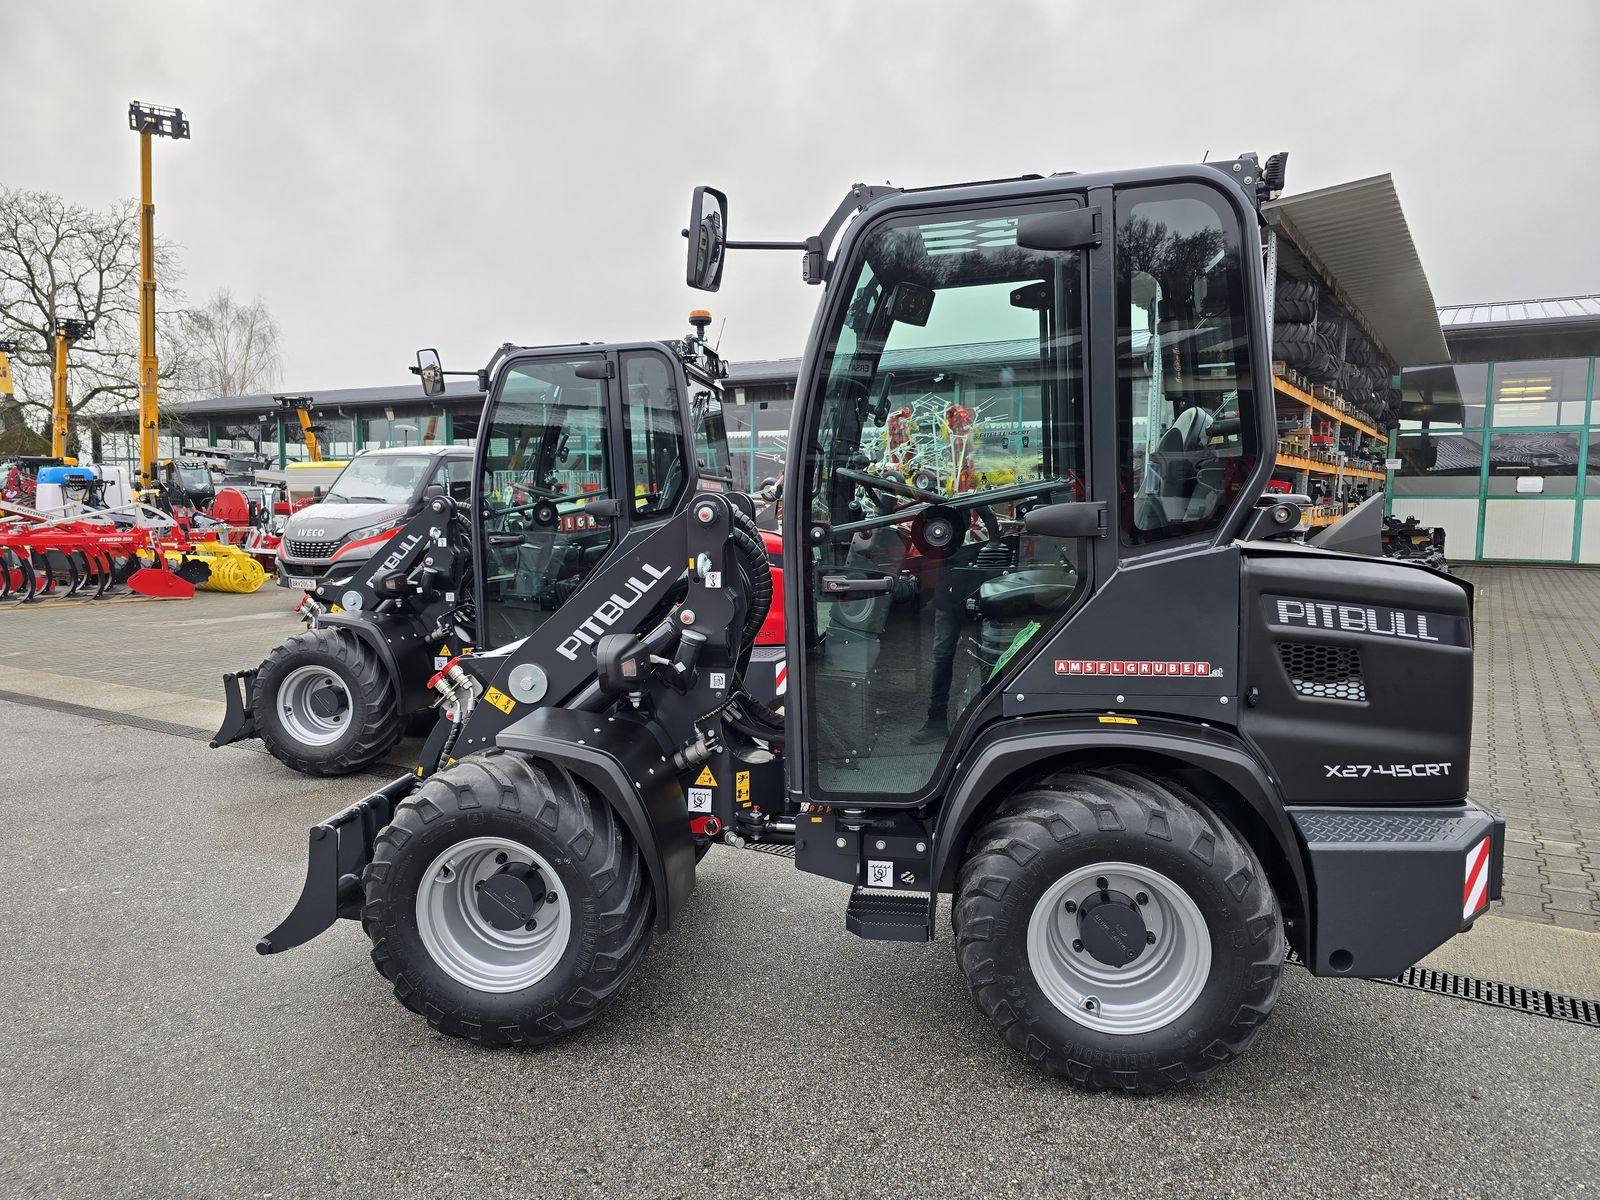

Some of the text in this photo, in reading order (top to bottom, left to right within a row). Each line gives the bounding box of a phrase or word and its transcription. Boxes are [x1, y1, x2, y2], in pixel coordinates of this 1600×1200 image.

[297, 528, 325, 537] IVECO
[555, 563, 672, 661] PITBULL
[1276, 600, 1439, 641] PITBULL
[1324, 763, 1452, 778] X27-45CRT
